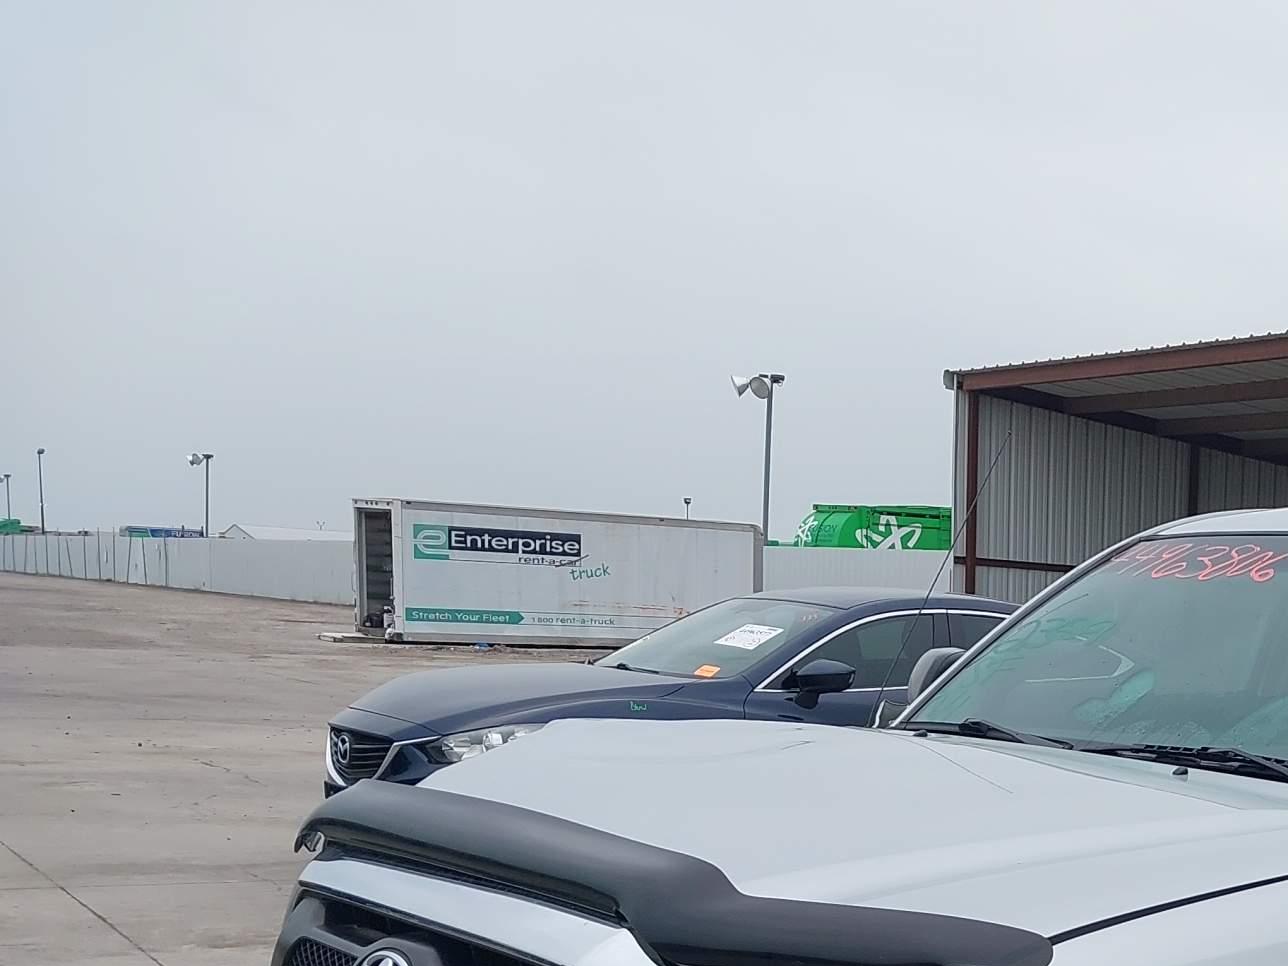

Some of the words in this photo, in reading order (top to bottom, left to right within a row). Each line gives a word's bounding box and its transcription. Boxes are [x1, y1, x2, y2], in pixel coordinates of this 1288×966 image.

[450, 530, 580, 555] Enterprise
[518, 556, 577, 567] rent-a-car
[569, 561, 611, 581] truck
[411, 610, 452, 621] Stretch
[455, 612, 481, 622] Your
[482, 613, 510, 623] Fleet
[555, 616, 616, 626] rent-a-truck
